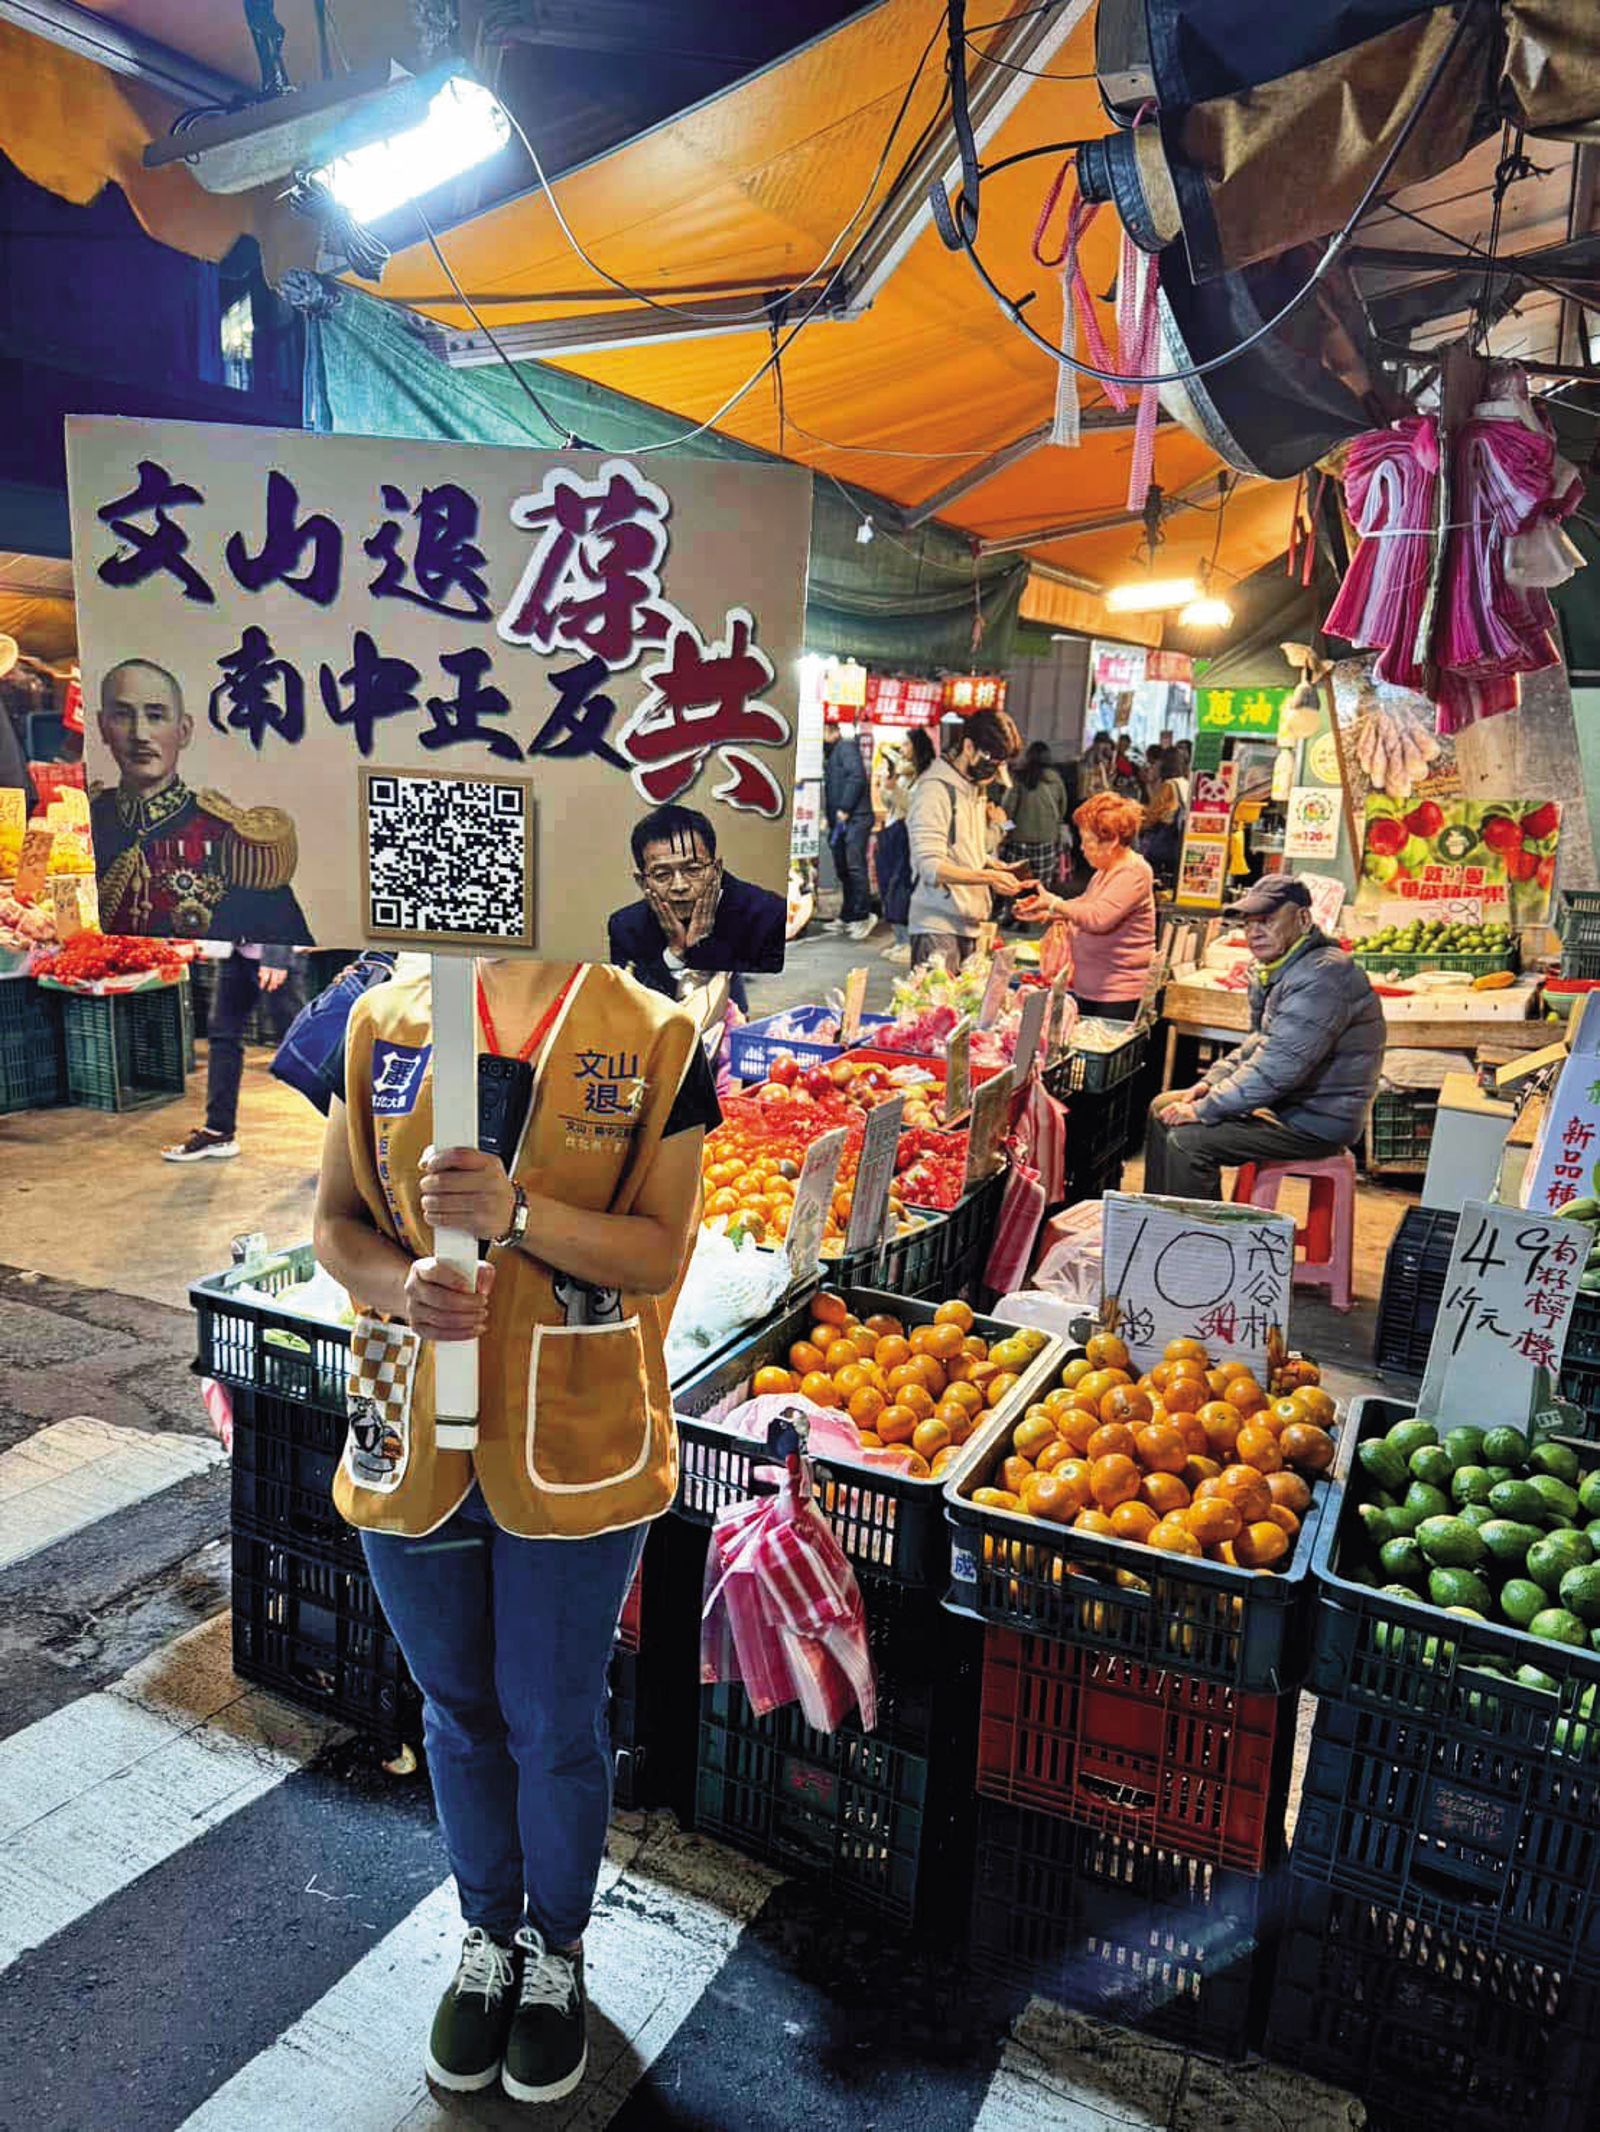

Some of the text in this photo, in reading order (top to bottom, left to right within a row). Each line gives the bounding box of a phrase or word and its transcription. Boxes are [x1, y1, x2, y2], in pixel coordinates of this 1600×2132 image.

[209, 609, 790, 818] 南中正反共
[573, 1049, 641, 1080] 文山
[1545, 1115, 1597, 1209] 新品種
[1117, 1216, 1236, 1309] 10
[1460, 1218, 1552, 1286] 49
